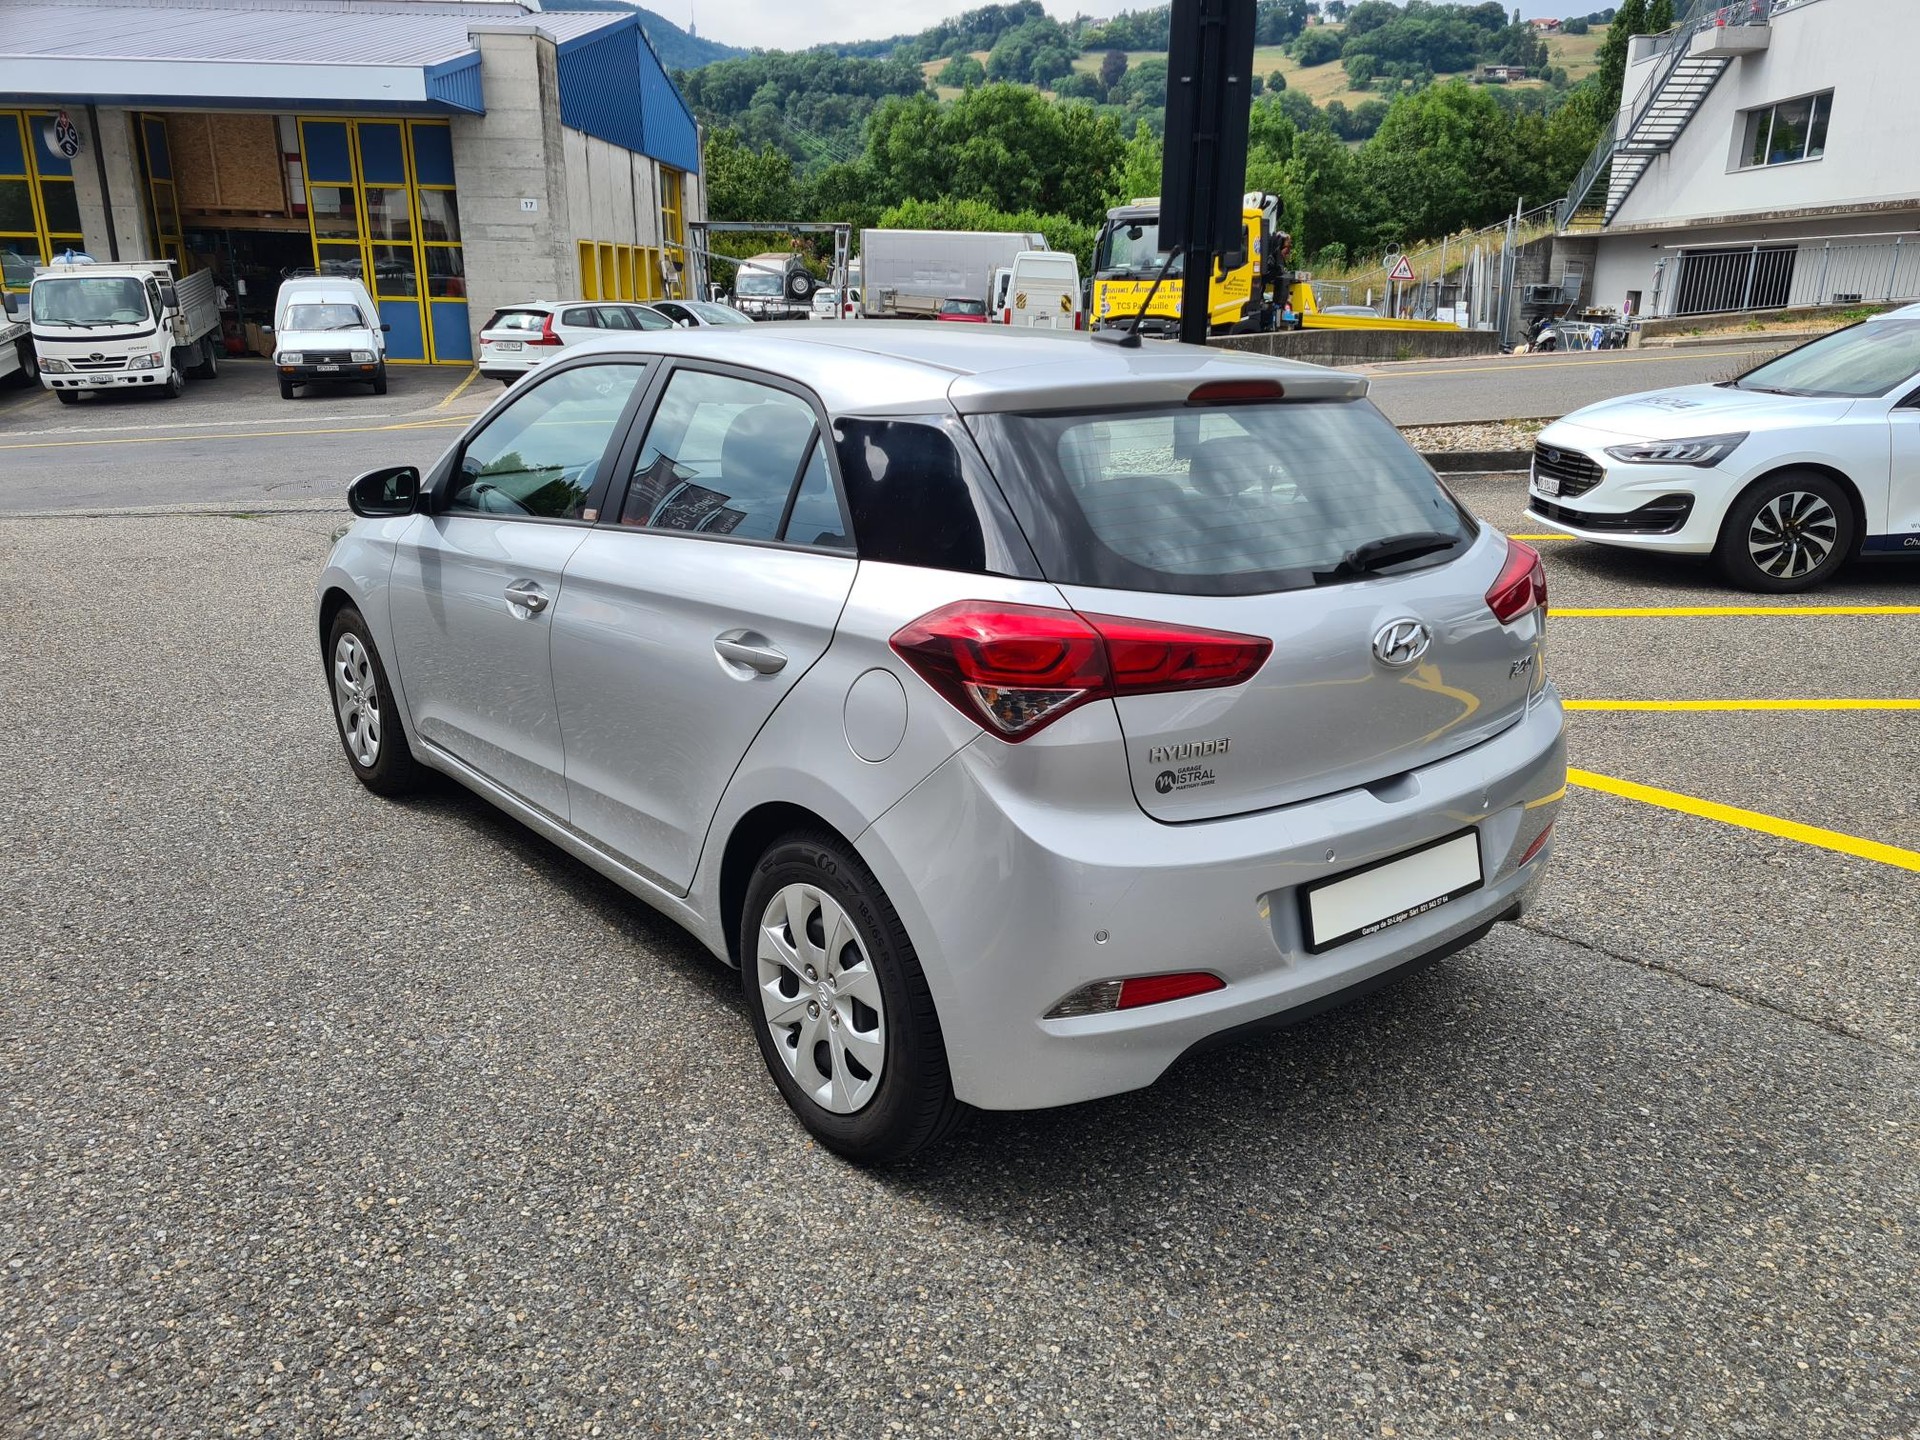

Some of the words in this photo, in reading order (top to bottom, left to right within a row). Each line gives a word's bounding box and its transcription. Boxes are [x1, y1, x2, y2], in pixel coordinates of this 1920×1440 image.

[524, 201, 534, 209] 17
[1117, 302, 1131, 310] TCS
[1149, 737, 1231, 763] HYUNDAI
[1177, 765, 1203, 774] GARAGE
[1362, 925, 1380, 936] Garage
